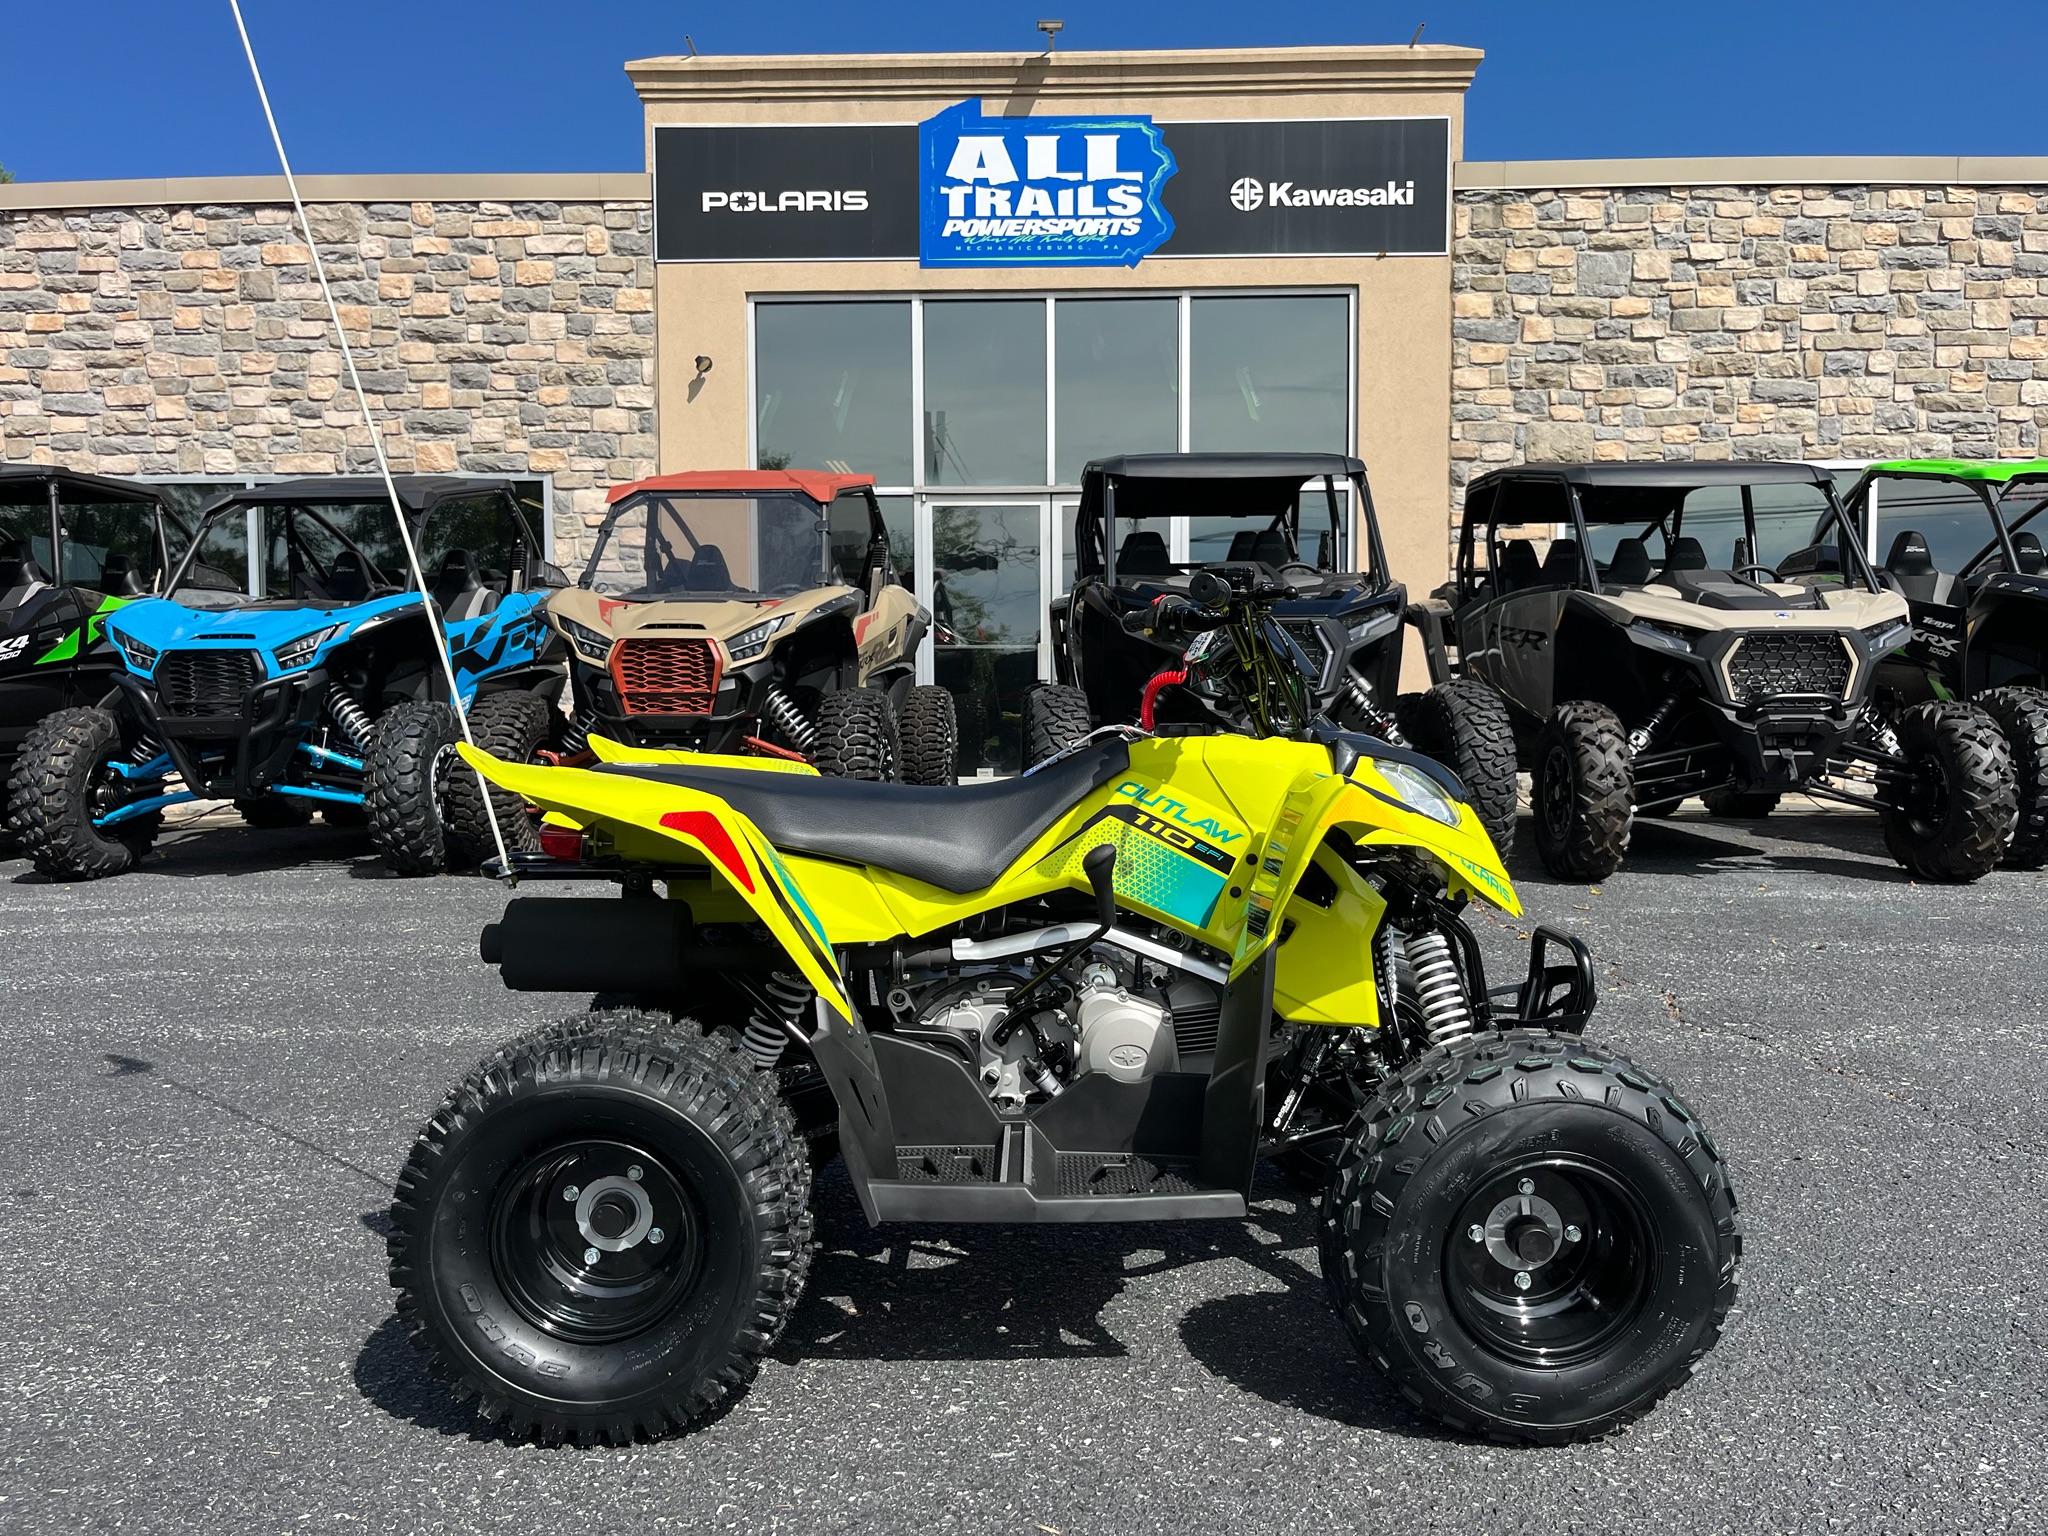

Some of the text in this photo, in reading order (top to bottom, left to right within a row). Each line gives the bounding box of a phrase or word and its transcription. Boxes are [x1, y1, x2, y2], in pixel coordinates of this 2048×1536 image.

[945, 134, 1143, 185] ALL
[702, 190, 869, 212] POLARIS
[940, 184, 1143, 217] TRAILS
[1269, 180, 1415, 207] Kawasaki
[941, 218, 1142, 237] POWERSPORTS
[963, 233, 1008, 245] Where
[1009, 233, 1035, 245] All
[1038, 233, 1076, 244] Trails
[1922, 616, 1957, 630] Teryx
[1488, 623, 1548, 652] RZR
[1911, 628, 1961, 653] KRX
[1928, 646, 1951, 658] 1000
[1115, 781, 1244, 843] OUTLAW
[1133, 813, 1224, 861] 110 EFI
[1448, 851, 1511, 903] OLARIS
[459, 1282, 571, 1380] DURO
